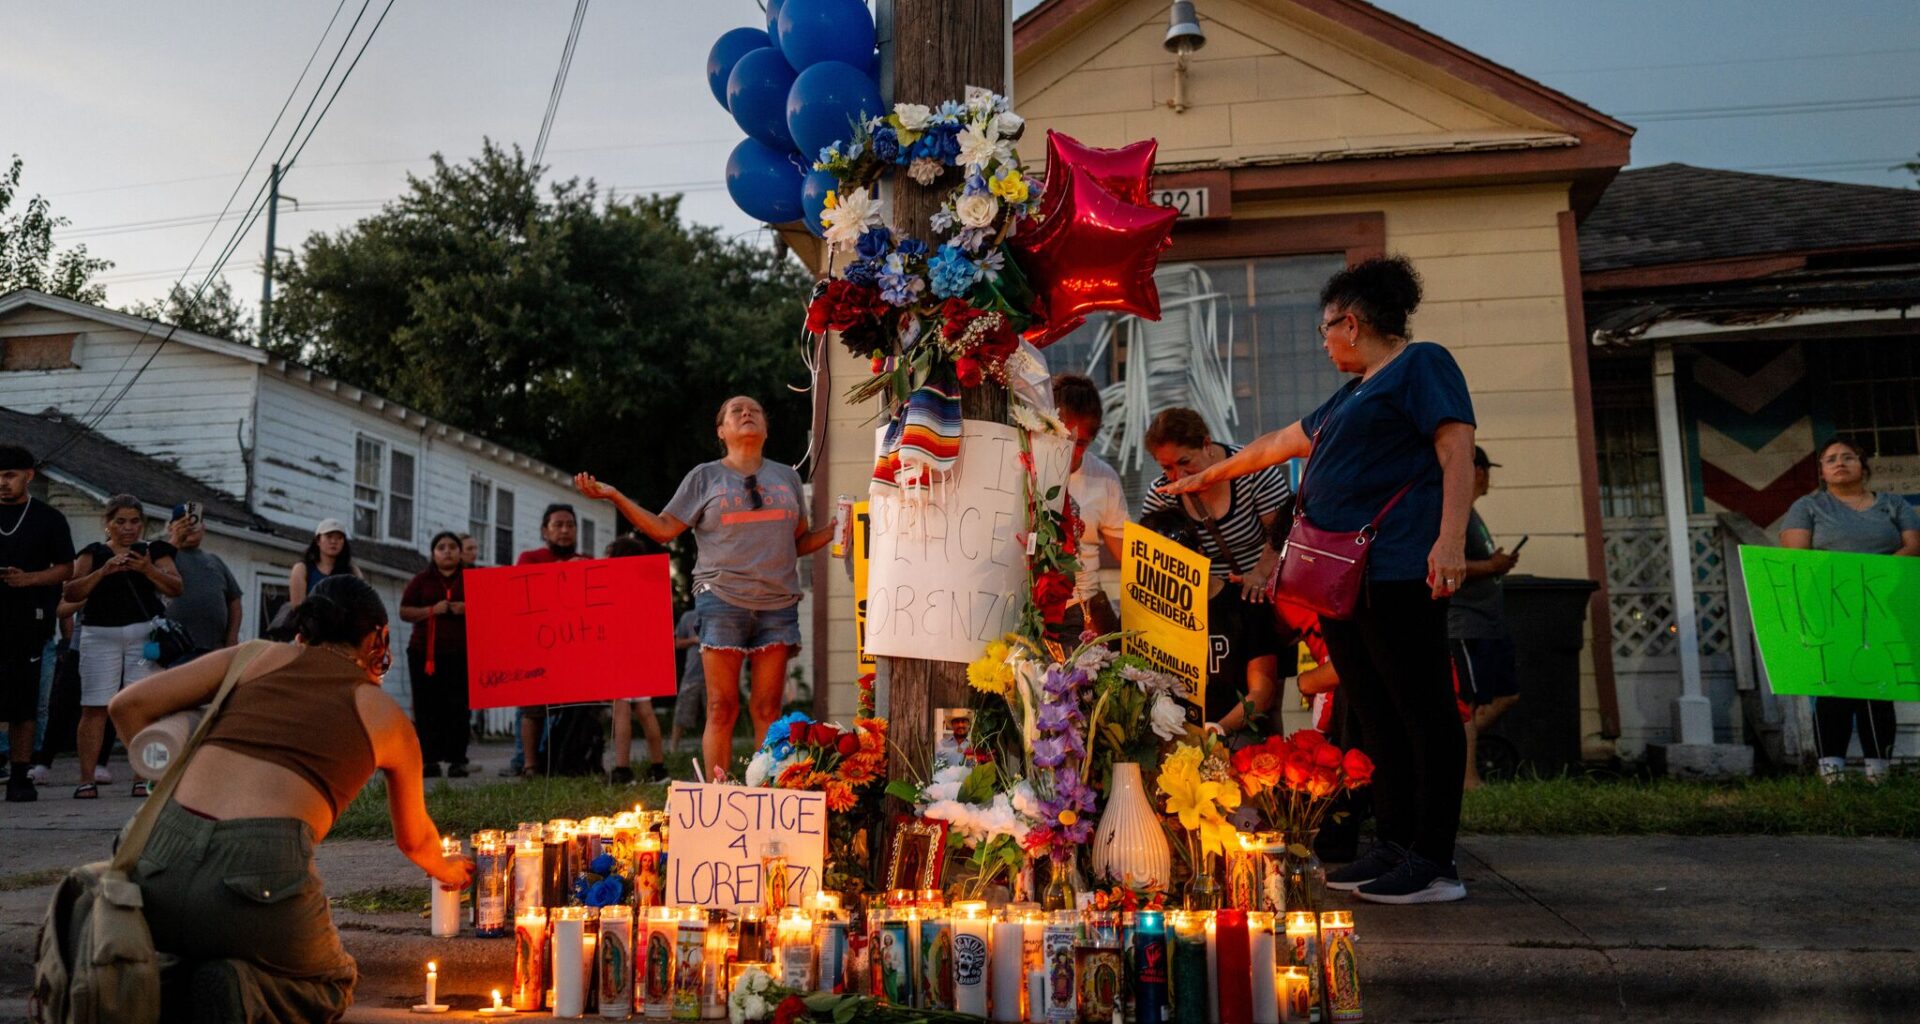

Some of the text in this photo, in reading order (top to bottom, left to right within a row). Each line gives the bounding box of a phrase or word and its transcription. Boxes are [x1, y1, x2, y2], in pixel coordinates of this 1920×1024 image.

[1131, 540, 1200, 587] ¡EL PUEBLO
[1136, 560, 1193, 611] UNIDO
[509, 565, 613, 616] ICE
[1131, 587, 1196, 631] DEFENDERÁ
[1134, 634, 1149, 653] LAS
[1151, 646, 1199, 679] FAMILIAS
[1804, 640, 1920, 686] ICE
[675, 788, 822, 834] JUSTICE
[728, 834, 748, 858] 4
